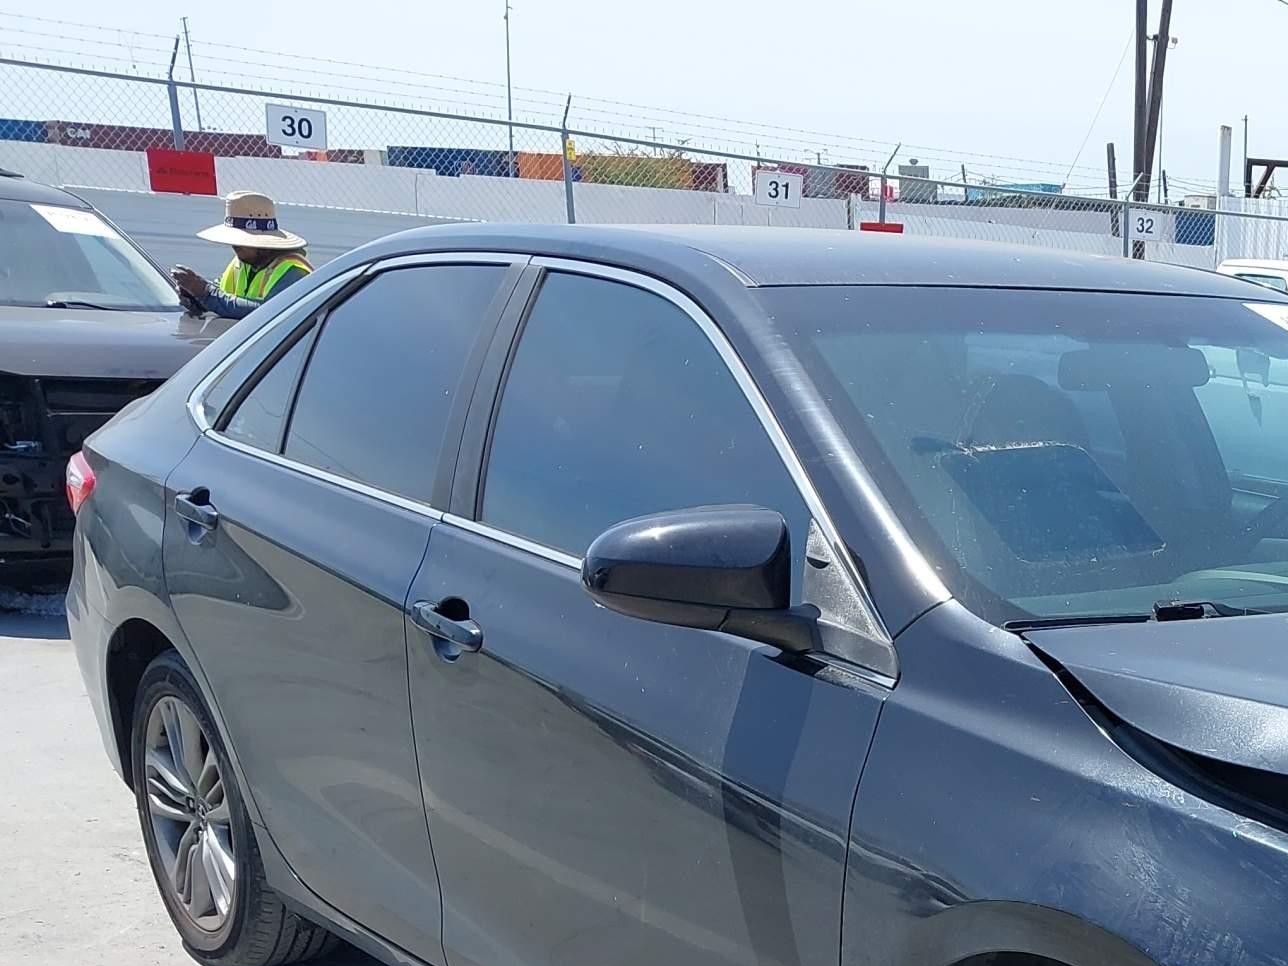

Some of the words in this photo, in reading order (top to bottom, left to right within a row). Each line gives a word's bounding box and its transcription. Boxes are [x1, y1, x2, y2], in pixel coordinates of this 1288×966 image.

[281, 115, 313, 139] 30
[767, 180, 789, 200] 31
[1136, 217, 1154, 234] 32
